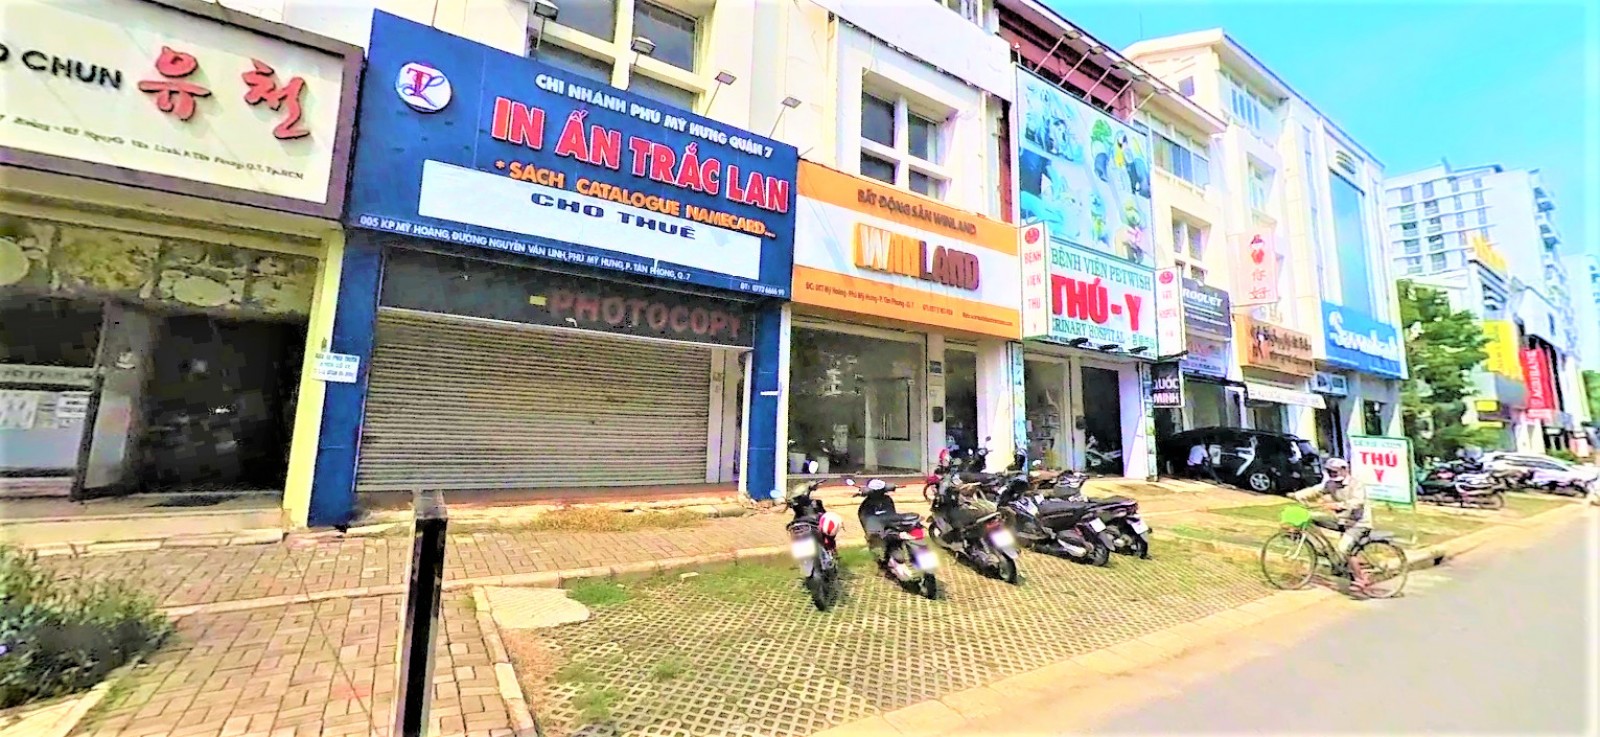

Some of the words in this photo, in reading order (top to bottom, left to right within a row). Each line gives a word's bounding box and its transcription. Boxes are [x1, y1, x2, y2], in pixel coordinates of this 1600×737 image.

[22, 50, 122, 90] CHUN
[535, 73, 565, 95] CHI
[568, 83, 626, 114] NHÁNH
[630, 102, 661, 124] PHÚ
[664, 113, 687, 132] MỸ
[689, 122, 727, 145] HƯNG
[764, 146, 774, 159] 7
[491, 96, 545, 150] IN
[555, 110, 621, 170] ẤN
[629, 136, 720, 195] TRẮC
[726, 164, 789, 214] LAN
[509, 161, 564, 189] SÁCH
[576, 178, 680, 216] CATALOGUE
[858, 188, 877, 206] BẤT
[360, 216, 378, 226] 005
[531, 192, 604, 218] CHO
[617, 211, 696, 240] THUÊ
[854, 222, 980, 291] WINLAND
[1051, 247, 1081, 272] BỆNH
[1084, 257, 1107, 279] VIỆN
[1109, 265, 1151, 291] PETWISH
[550, 290, 741, 339] PHOTOCOPY
[1051, 273, 1108, 325] THÚ
[1124, 294, 1142, 331] Y
[1153, 392, 1179, 403] MINH
[1360, 450, 1398, 467] THÚ
[1374, 469, 1384, 483] Y
